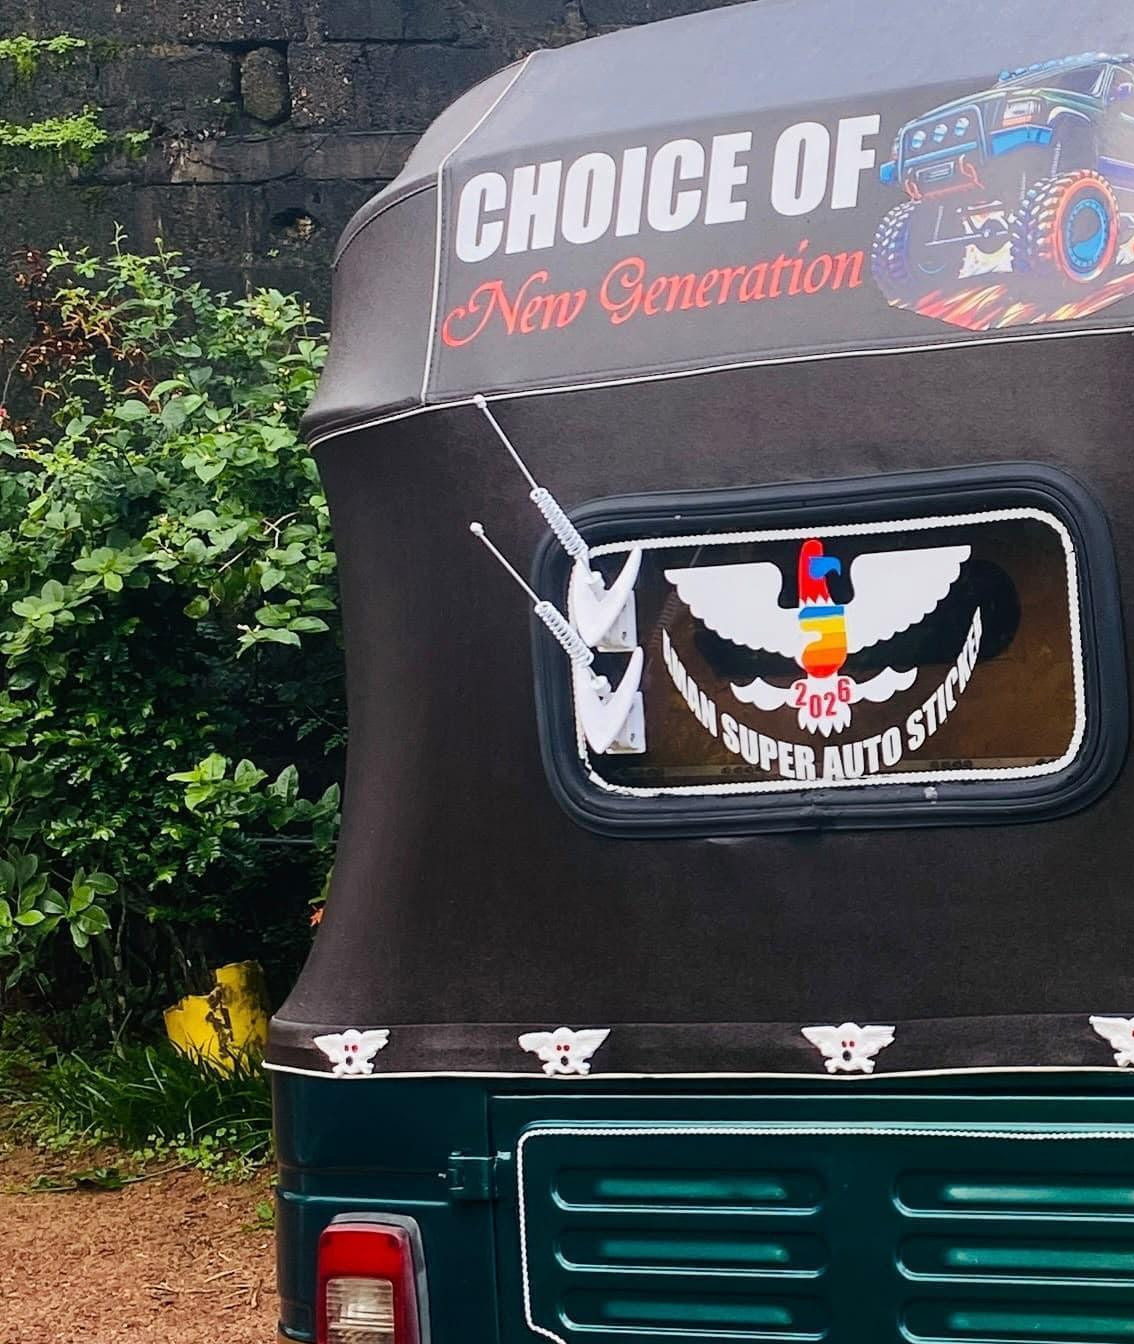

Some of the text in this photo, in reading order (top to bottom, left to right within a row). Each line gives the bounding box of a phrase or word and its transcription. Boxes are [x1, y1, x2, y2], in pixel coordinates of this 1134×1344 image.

[455, 113, 882, 263] CHOICE OF
[441, 240, 864, 348] New Generation
[794, 677, 851, 719] 2026
[720, 712, 817, 780] SUPER
[822, 726, 902, 780] AUTO
